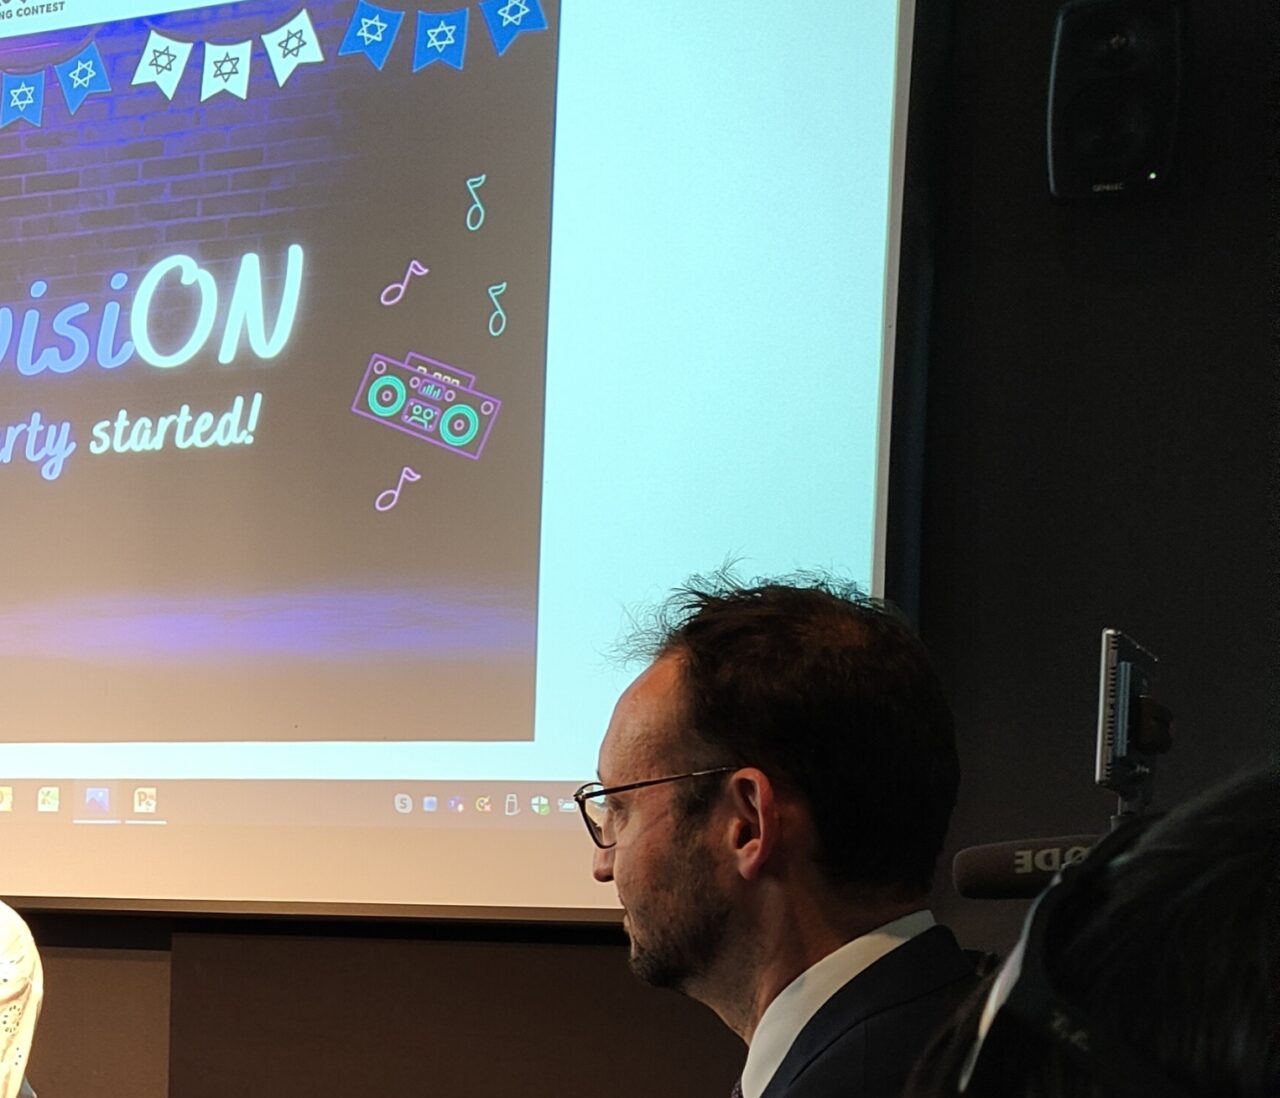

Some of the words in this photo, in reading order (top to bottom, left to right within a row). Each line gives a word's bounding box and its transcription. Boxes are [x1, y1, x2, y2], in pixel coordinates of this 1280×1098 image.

[16, 2, 65, 17] CONTEST
[89, 392, 263, 456] started!
[1013, 846, 1090, 874] ØDE
